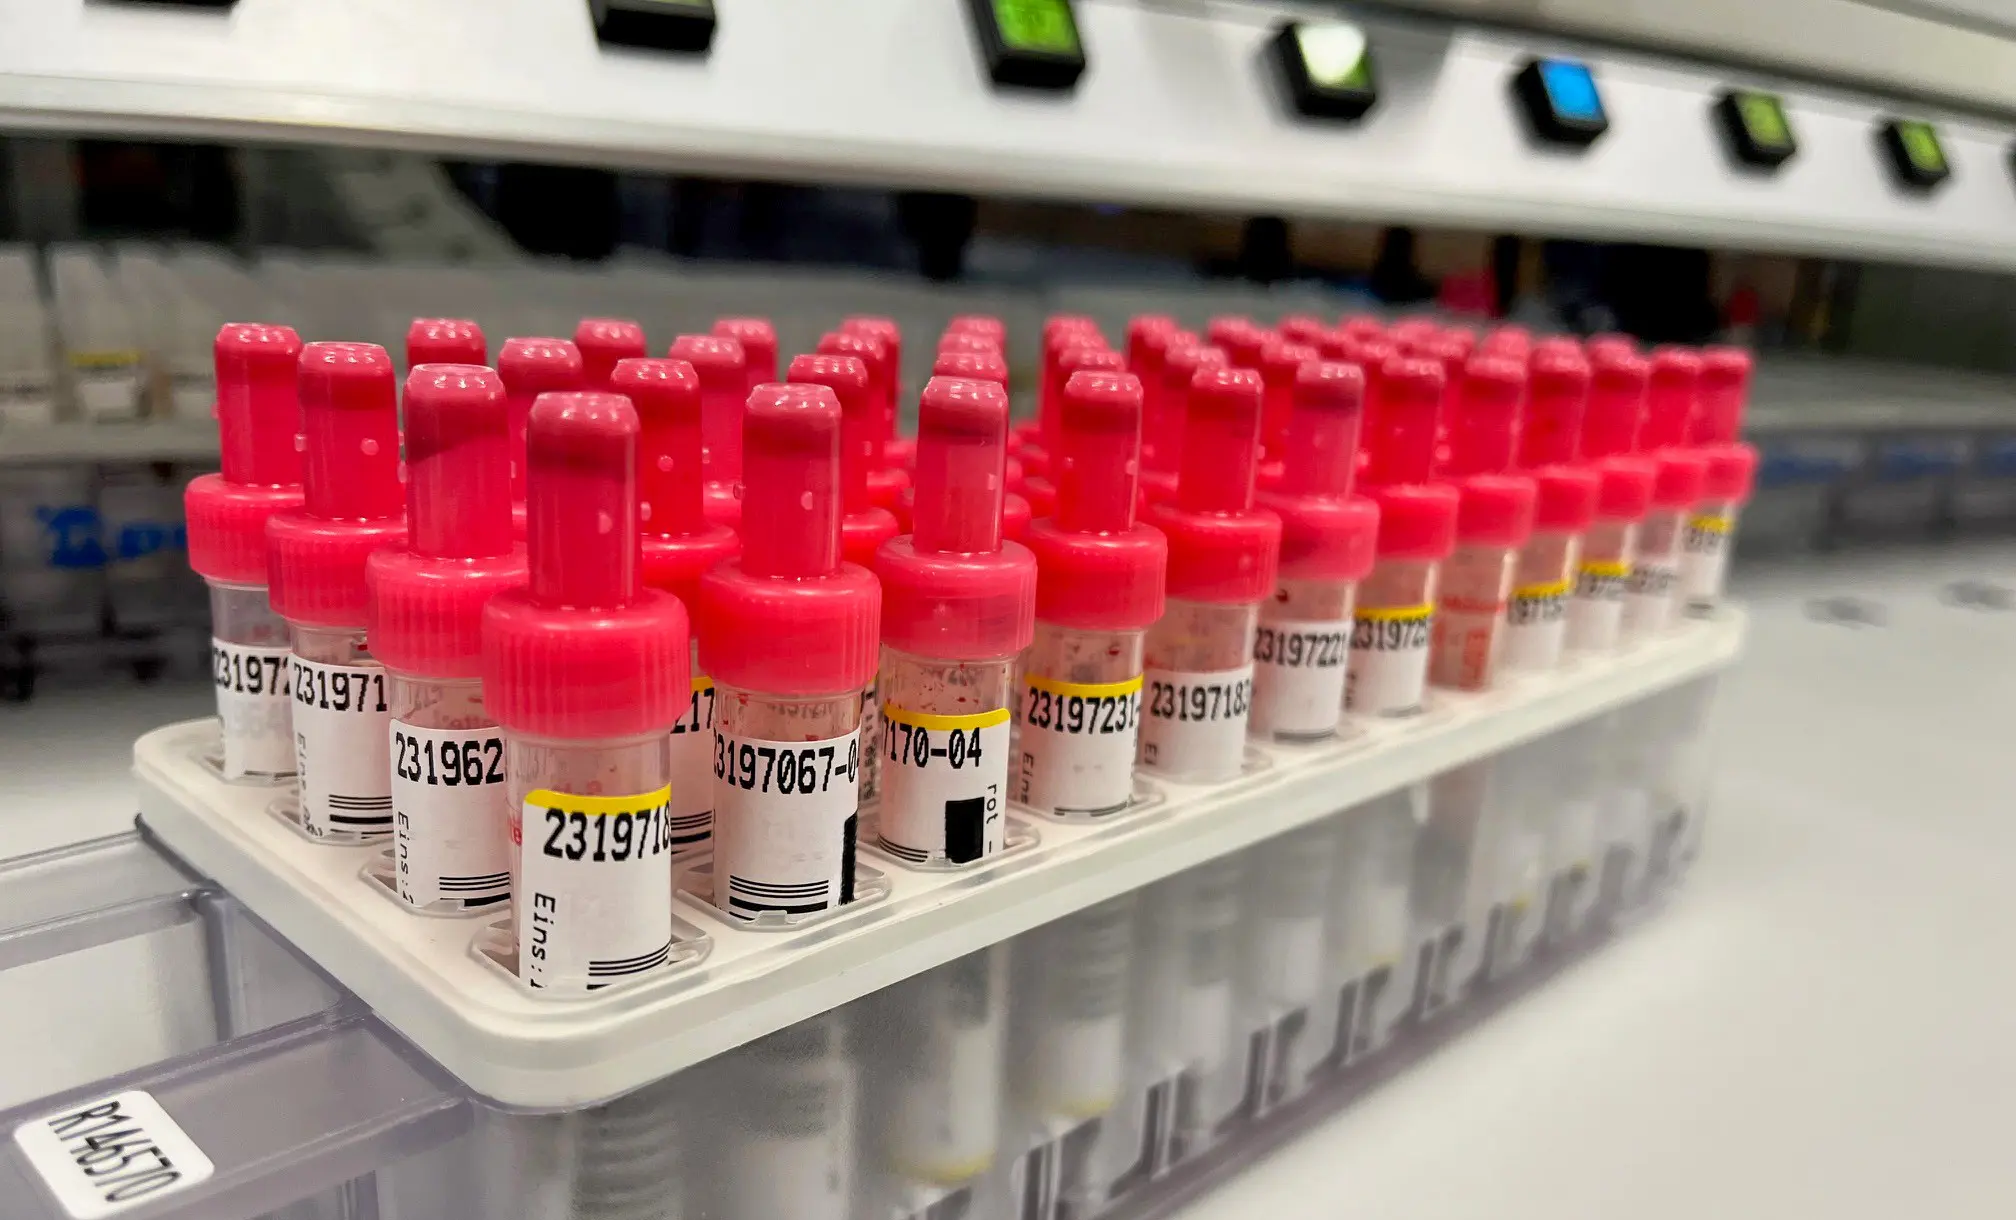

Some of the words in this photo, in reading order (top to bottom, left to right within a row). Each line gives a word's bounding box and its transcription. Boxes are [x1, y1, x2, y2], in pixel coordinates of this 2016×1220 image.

[294, 663, 388, 712] 231971
[395, 731, 506, 787] 231962
[987, 784, 1003, 824] rot
[47, 1101, 183, 1203] R146570
